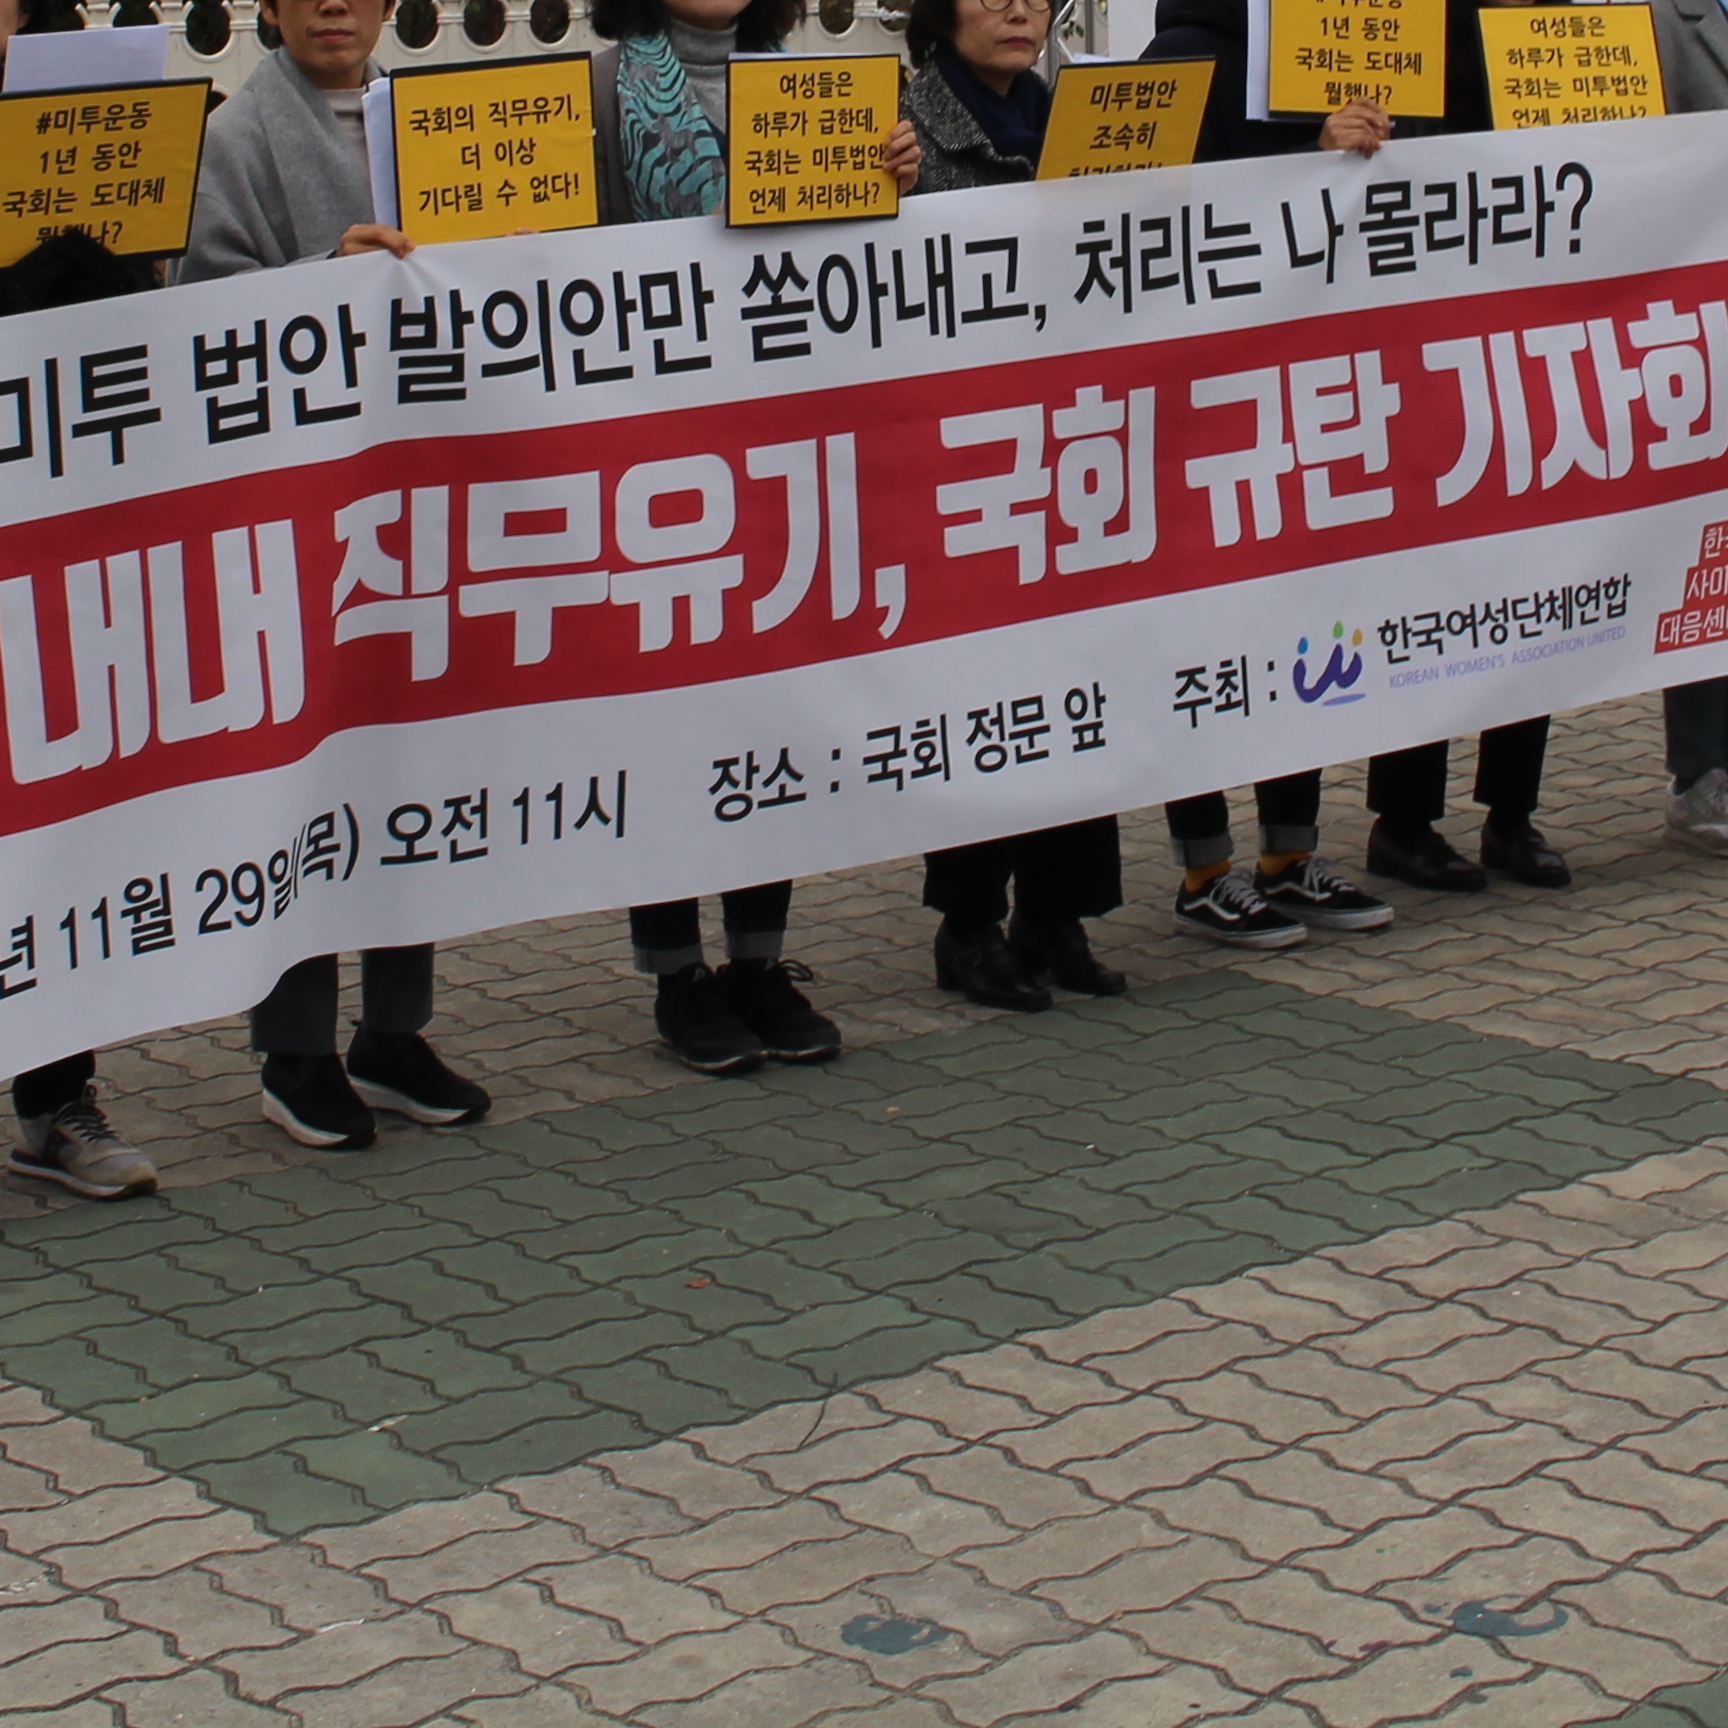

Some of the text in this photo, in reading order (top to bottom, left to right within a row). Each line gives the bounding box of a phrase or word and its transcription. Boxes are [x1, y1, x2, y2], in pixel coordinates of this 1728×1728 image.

[1321, 17, 1400, 41] 1년 동안
[1530, 16, 1606, 38] 여성들은
[1295, 48, 1422, 75] 국회는 도대체
[1507, 46, 1638, 69] 하루가 급한데,
[780, 72, 853, 99] 여성들은
[1090, 79, 1178, 112] 미투법안
[1504, 75, 1648, 99] 국회는 미투법안
[36, 101, 152, 135] #미투운동
[410, 94, 580, 136] 국회의 직무유기,
[752, 107, 879, 138] 하루가 급한데,
[1089, 121, 1157, 151] 조속히
[40, 141, 142, 174] 1년 동안
[462, 138, 536, 171] 더 이상
[745, 145, 885, 176] 국회는 미투법안
[3, 177, 165, 218] 국회는 도대체
[419, 173, 580, 215] 기다릴 수 없다!
[750, 182, 880, 214] 언제 처리하나?
[193, 303, 367, 445] 법안
[390, 261, 714, 405] 발의안만
[740, 232, 1048, 361] 쏟아내고,
[1073, 203, 1263, 314] 처리는
[1282, 188, 1343, 283] 나
[1358, 162, 1594, 276] 몰라라?
[331, 432, 908, 683] 직무유기,
[936, 383, 1157, 586] 국회
[1185, 350, 1402, 548] 규탄
[1377, 573, 1632, 664] 한국여성단체연합
[1389, 626, 1626, 689] KOREAN WOMEN'S ASSOCIATION UNITED
[1172, 655, 1251, 729] 주최
[707, 746, 809, 823] 장소
[861, 714, 952, 793] 국회
[965, 694, 1051, 774] 정문
[1062, 681, 1108, 754] 앞
[60, 872, 177, 971] 11월
[195, 802, 361, 936] 29일(목)
[379, 787, 491, 867] 오전
[513, 769, 629, 845] 11시
